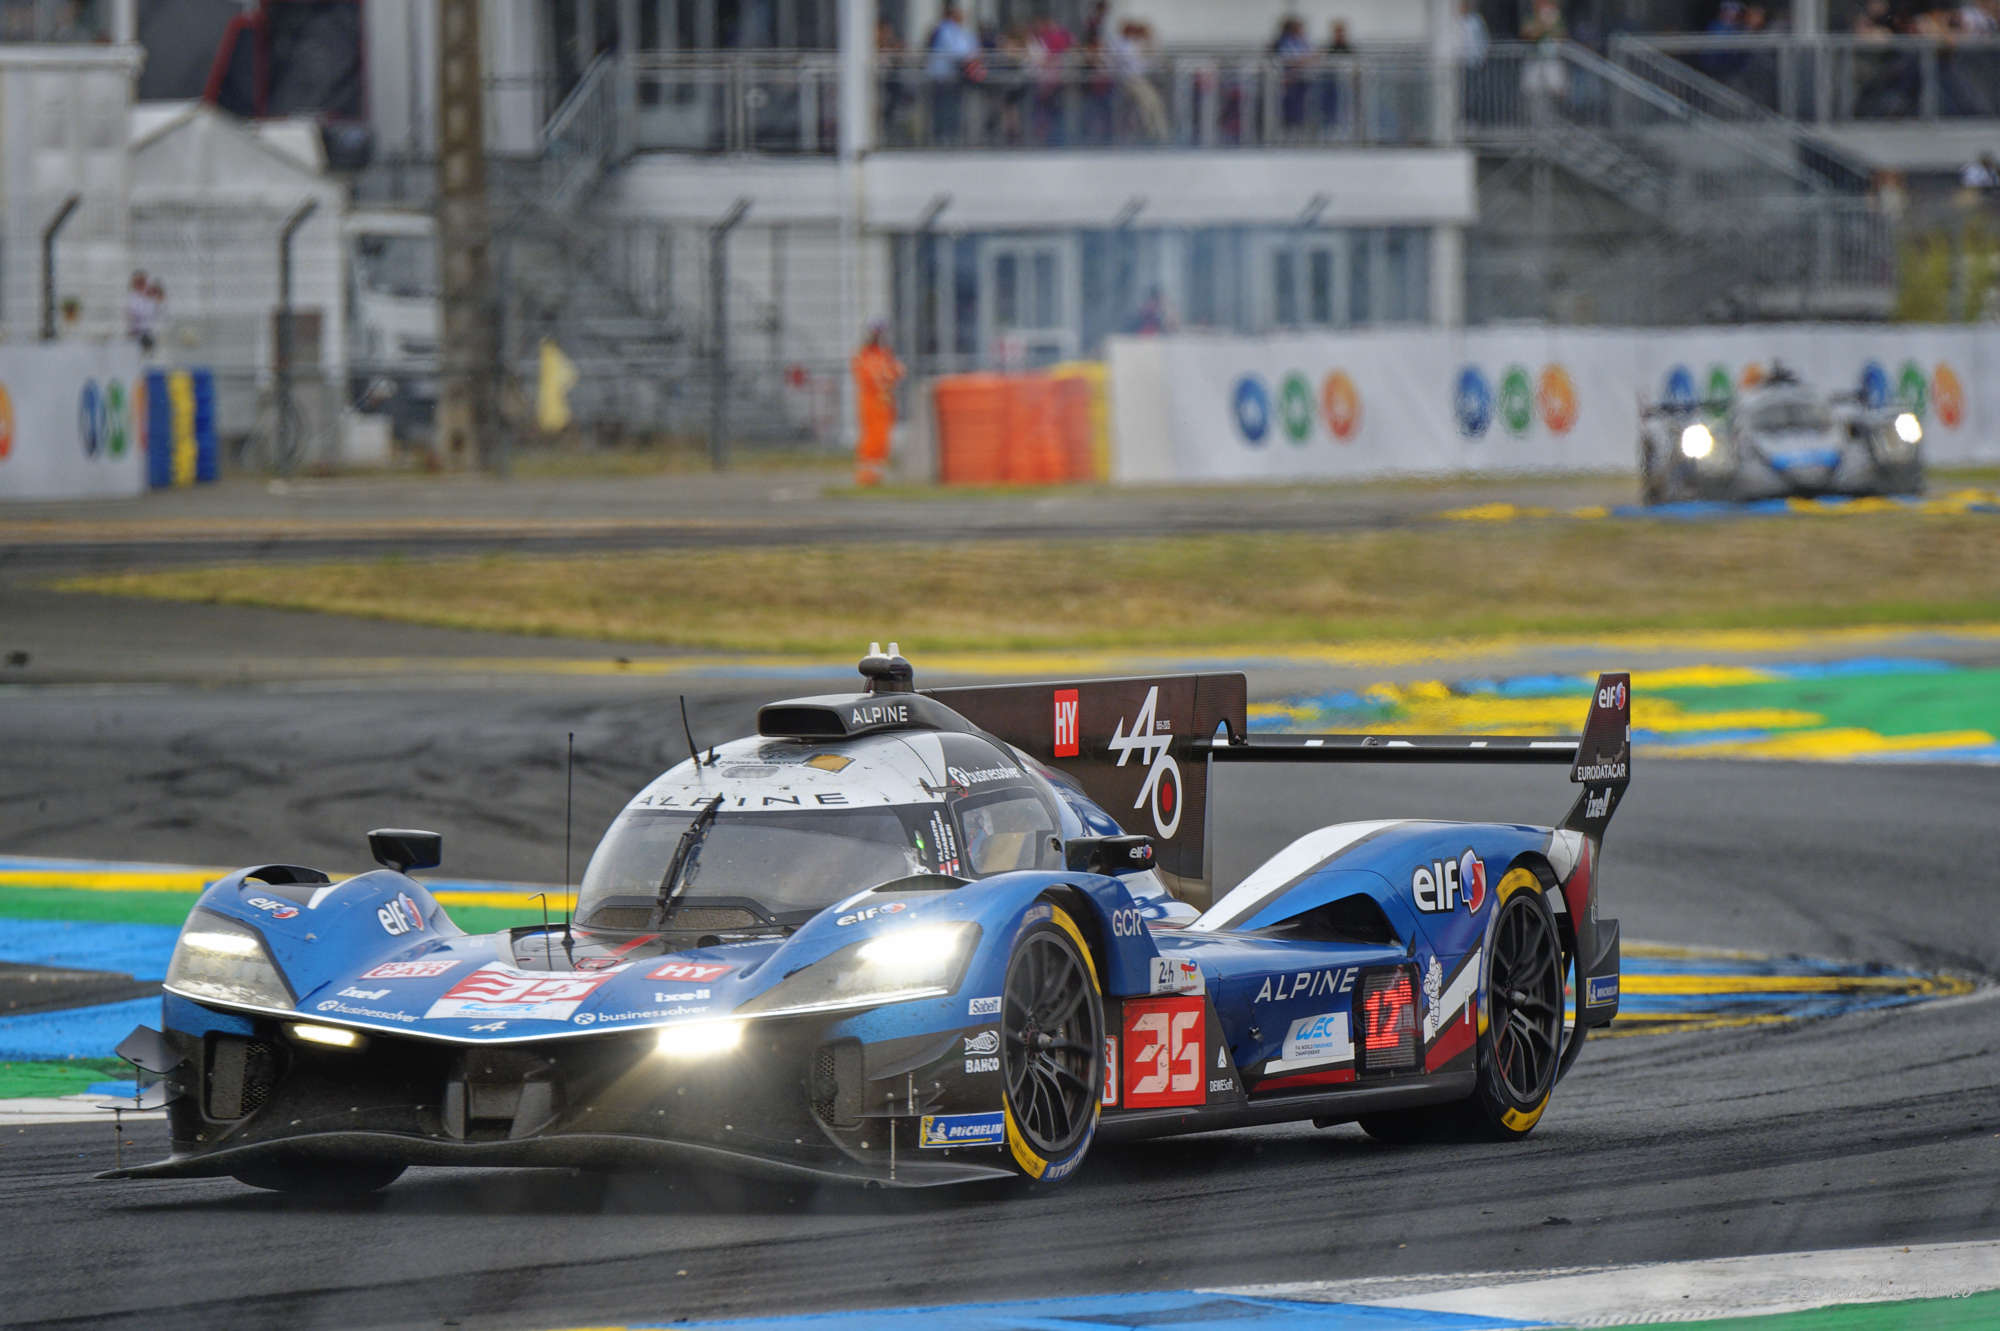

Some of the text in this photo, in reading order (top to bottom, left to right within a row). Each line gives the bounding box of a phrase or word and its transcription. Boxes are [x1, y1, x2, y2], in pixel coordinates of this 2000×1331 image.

[1598, 686, 1616, 709] elf
[851, 705, 908, 724] ALPINE
[1055, 701, 1077, 745] HY
[1577, 763, 1626, 781] EURODATACAR
[639, 792, 849, 807] ALPINE
[1129, 846, 1144, 859] elf
[1412, 859, 1459, 911] elf
[247, 897, 286, 911] elf
[377, 899, 411, 937] elf
[836, 907, 879, 927] elf
[1112, 909, 1142, 936] GCR
[655, 964, 723, 979] HY
[1254, 967, 1359, 1003] ALPINE
[599, 1005, 710, 1023] businessolver
[1296, 1016, 1335, 1041] WEC
[1131, 1011, 1200, 1094] 35
